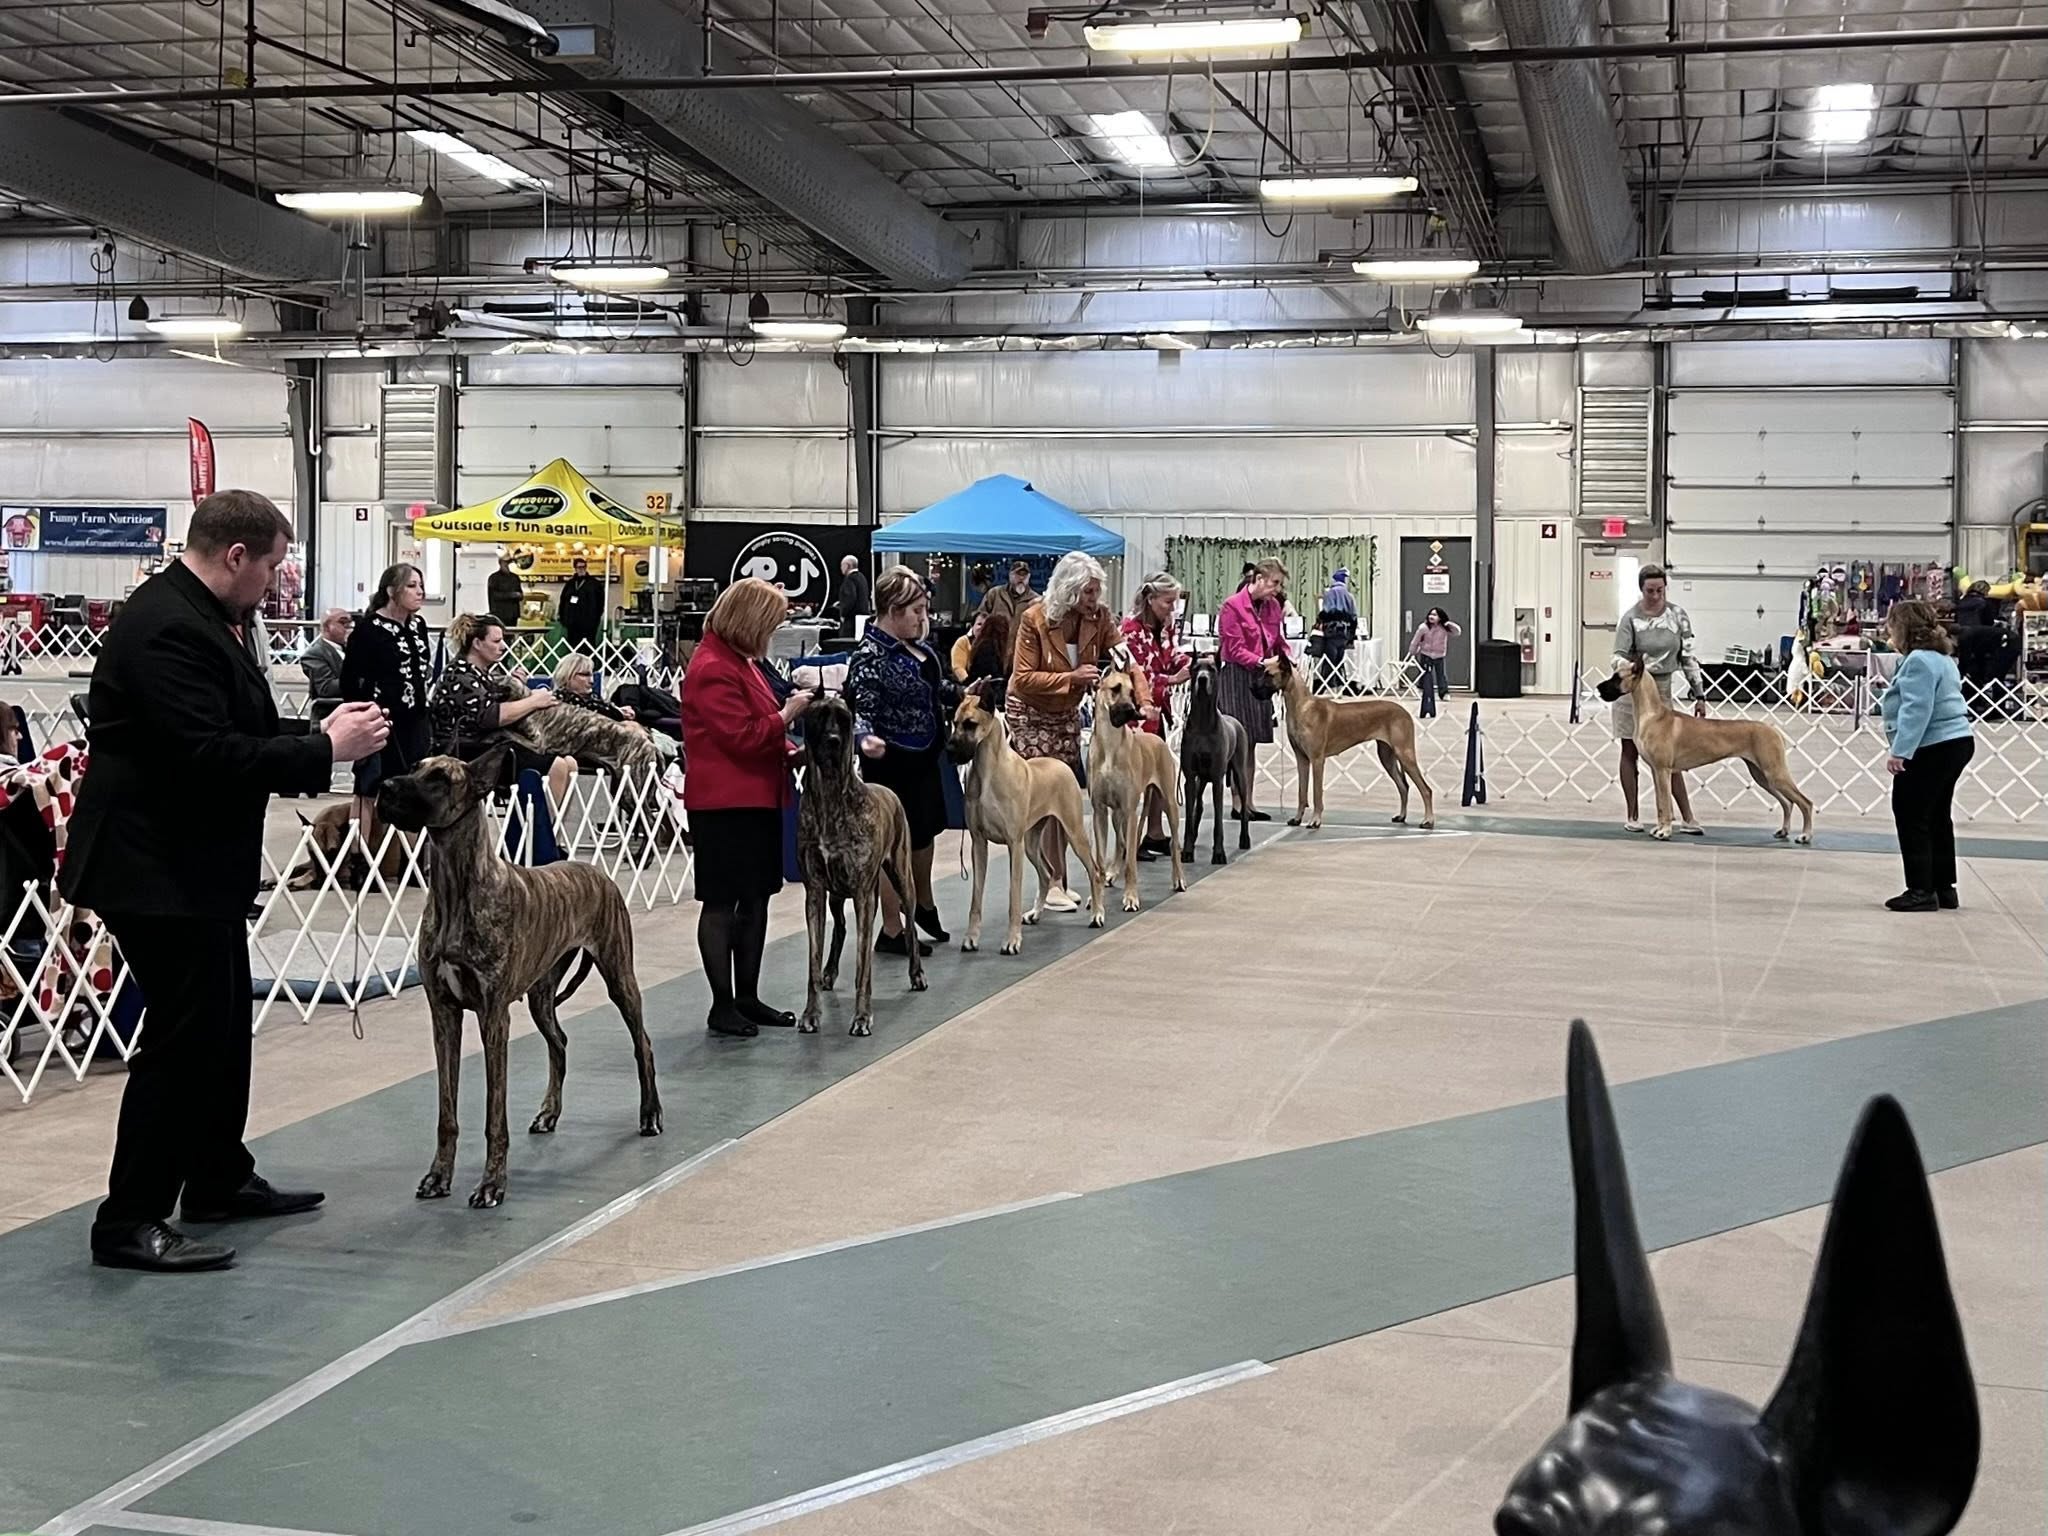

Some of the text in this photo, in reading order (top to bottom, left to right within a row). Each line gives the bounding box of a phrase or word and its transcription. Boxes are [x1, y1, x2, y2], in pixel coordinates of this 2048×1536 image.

[509, 496, 561, 505] MOSQUITO
[646, 495, 665, 510] 32
[357, 508, 367, 520] 3
[504, 504, 555, 516] JOE
[49, 511, 154, 526] Funny Farm Nutrition
[430, 519, 493, 532] Outside
[498, 521, 510, 532] is
[515, 520, 541, 533] fun
[1544, 525, 1554, 537] 4
[772, 537, 794, 545] saving
